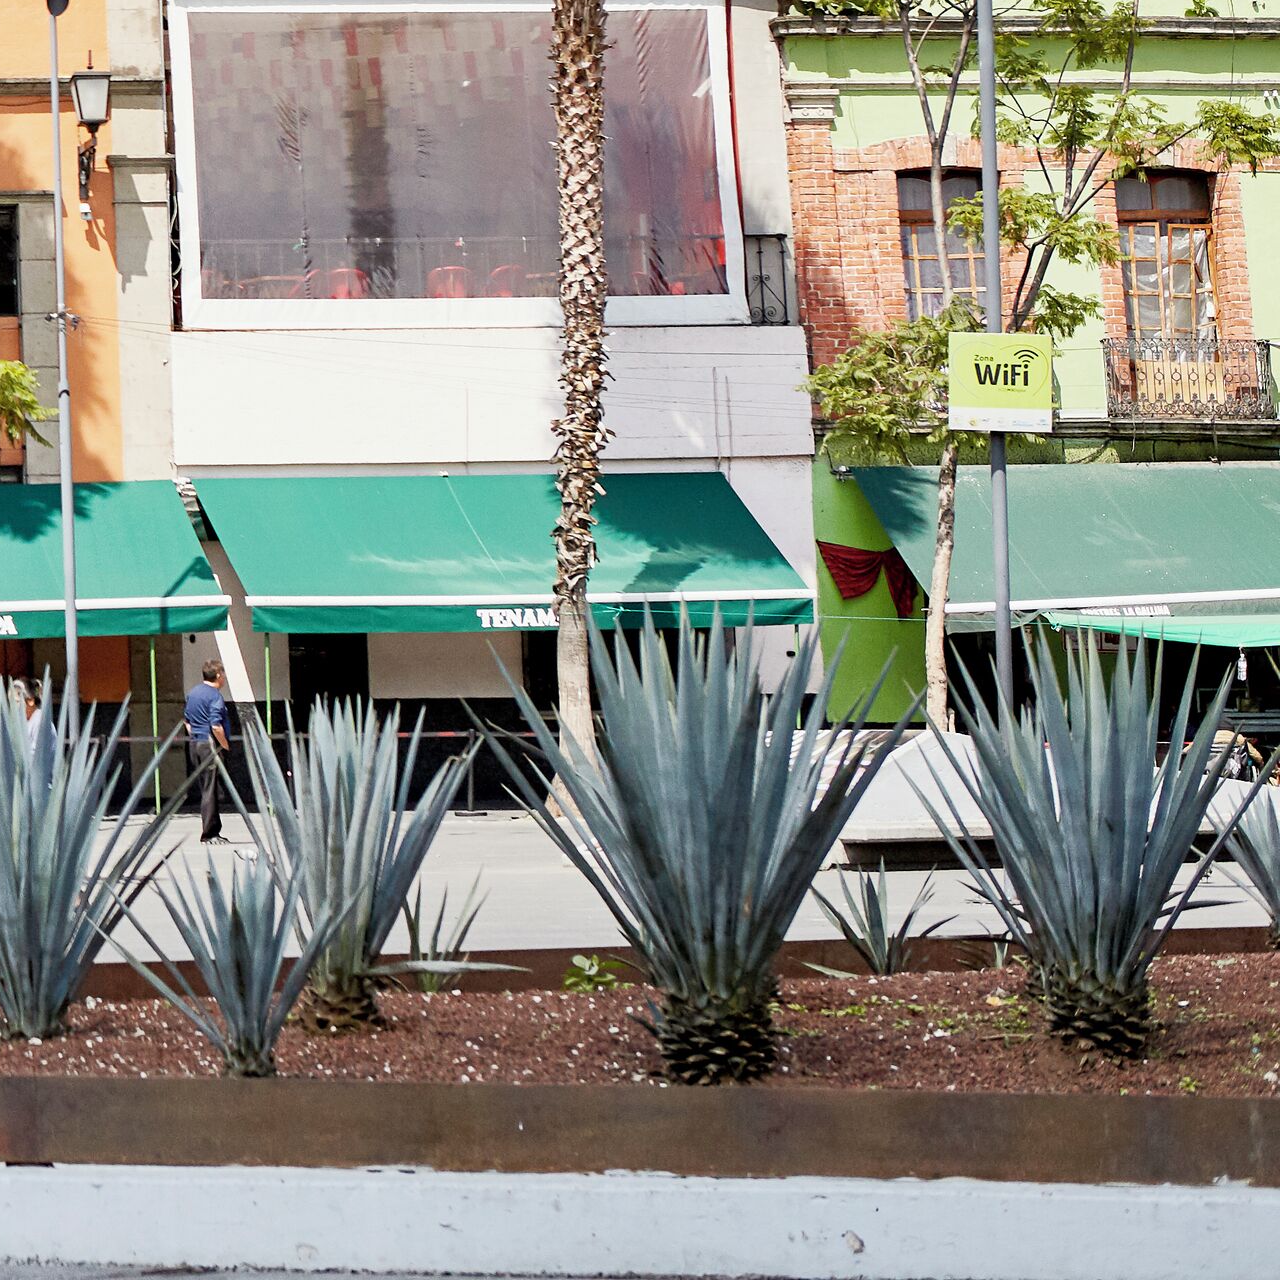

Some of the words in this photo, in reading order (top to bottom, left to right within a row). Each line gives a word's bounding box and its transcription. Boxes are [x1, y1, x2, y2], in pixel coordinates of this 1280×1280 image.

[974, 354, 994, 362] Zona
[974, 363, 1029, 386] WiFi
[476, 608, 560, 628] TENAM
